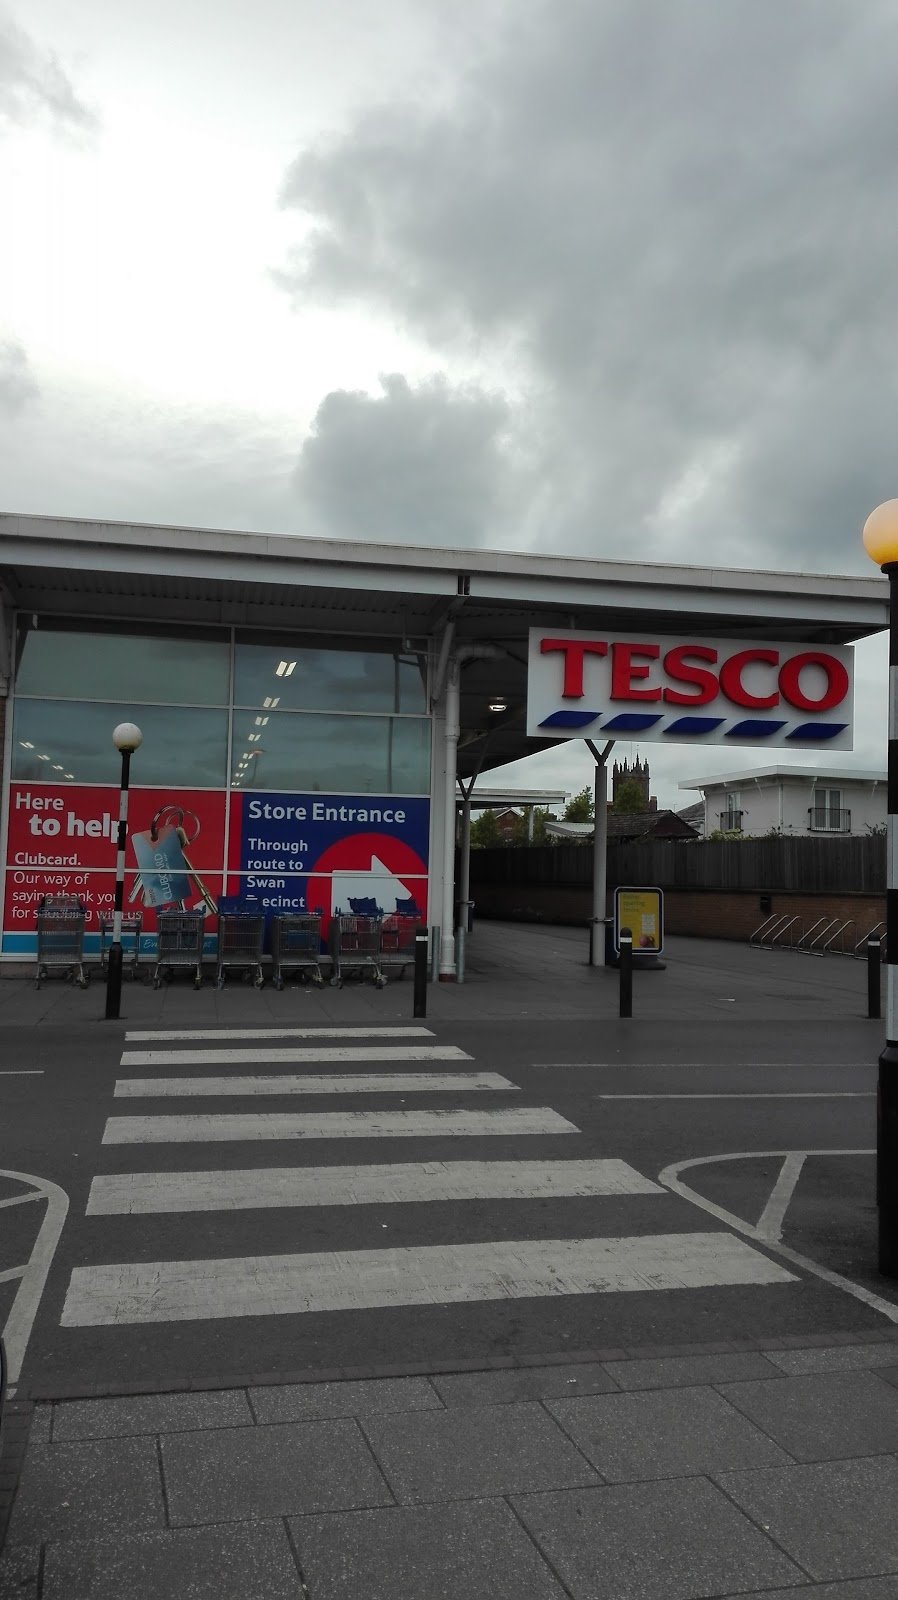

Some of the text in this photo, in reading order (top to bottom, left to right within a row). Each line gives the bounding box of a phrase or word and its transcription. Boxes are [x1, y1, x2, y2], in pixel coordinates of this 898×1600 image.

[540, 638, 849, 712] TESCO
[15, 792, 65, 811] Here
[248, 801, 406, 823] Store Entrance
[29, 812, 129, 844] to help
[248, 838, 309, 854] Through
[14, 852, 82, 866] Clubcard.
[247, 859, 304, 871] route to
[13, 871, 90, 888] Our way of
[246, 876, 286, 889] Swan
[12, 890, 54, 904] saying
[246, 894, 305, 908] ecinct
[12, 906, 31, 919] for
[127, 911, 144, 921] us
